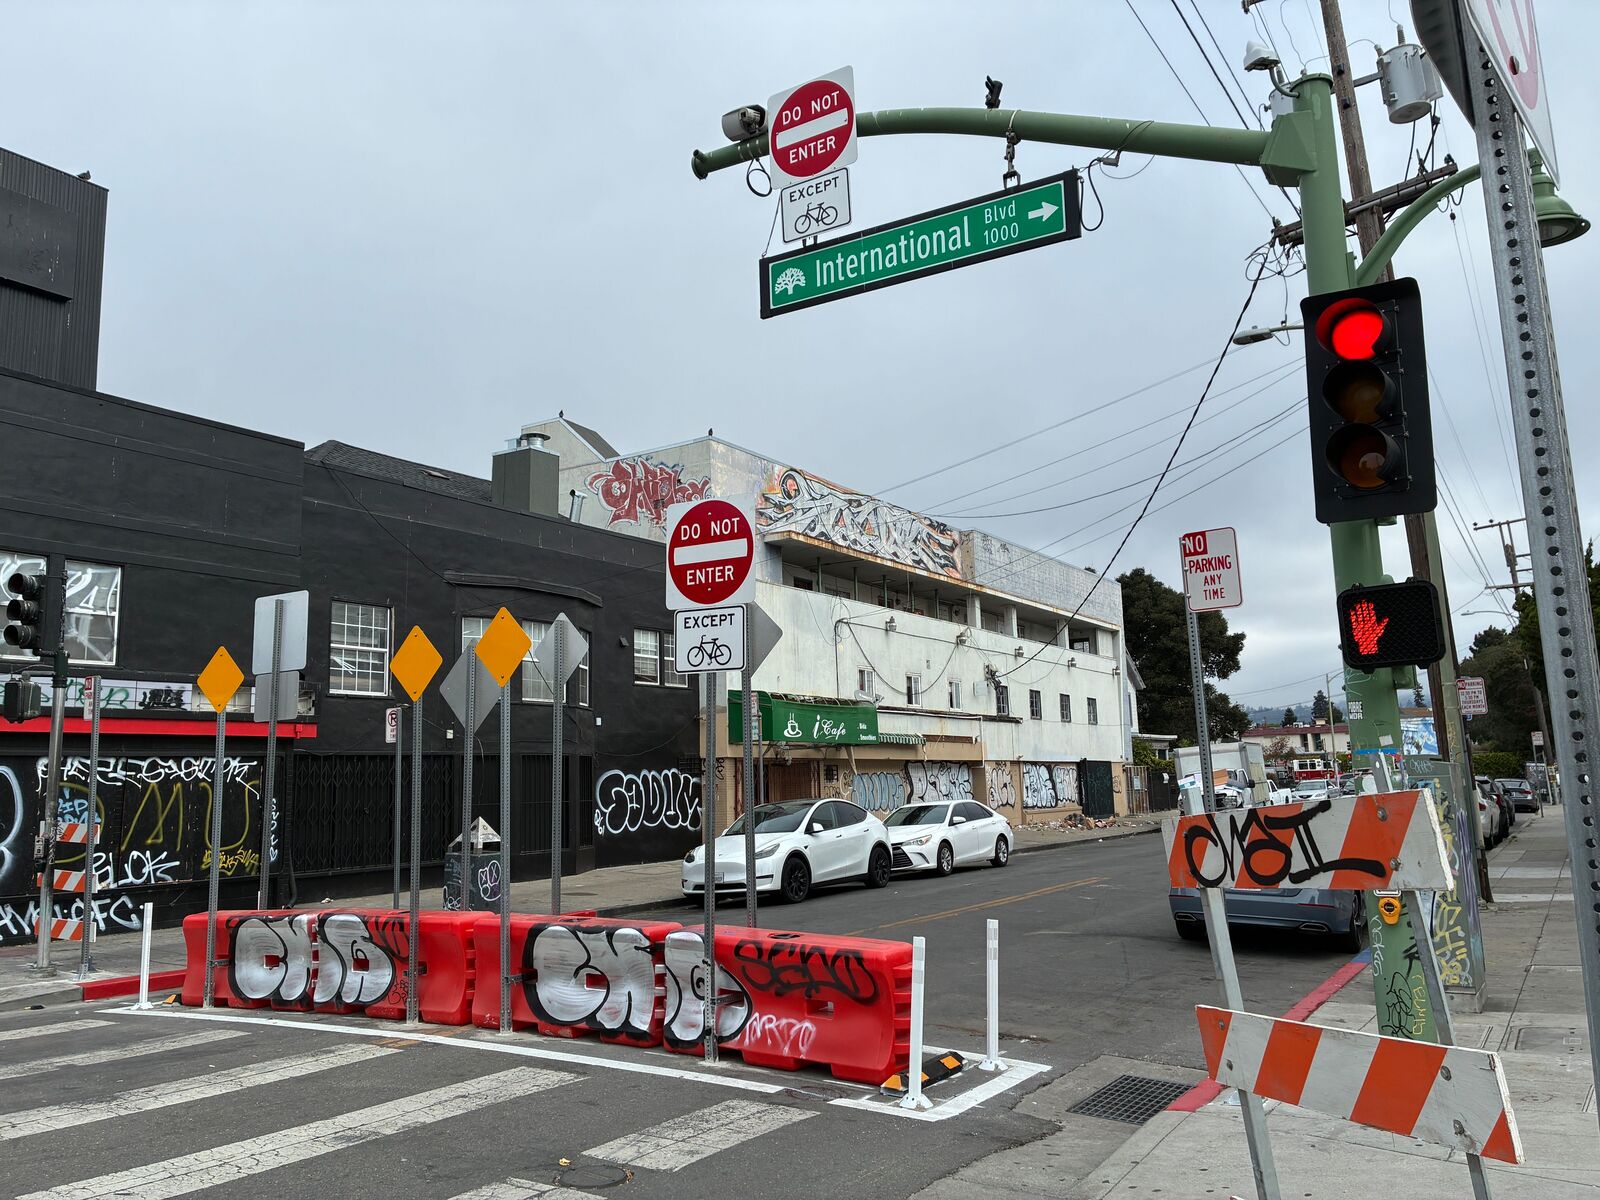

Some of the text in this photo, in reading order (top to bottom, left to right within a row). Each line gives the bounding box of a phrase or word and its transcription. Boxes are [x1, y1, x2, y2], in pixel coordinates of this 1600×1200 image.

[782, 91, 841, 126] DO NOT
[788, 136, 836, 164] ENTER
[789, 177, 839, 203] EXCEPT
[984, 200, 1016, 224] Blvd
[983, 222, 1019, 246] 1000
[815, 216, 971, 288] International
[680, 517, 740, 541] DO NOT
[1185, 535, 1205, 556] NO
[686, 565, 734, 586] ENTER
[1188, 555, 1232, 574] PARKING
[1203, 574, 1222, 586] ANY
[1203, 587, 1226, 601] TIME
[683, 613, 736, 630] EXCEPT
[821, 719, 846, 740] Cafe
